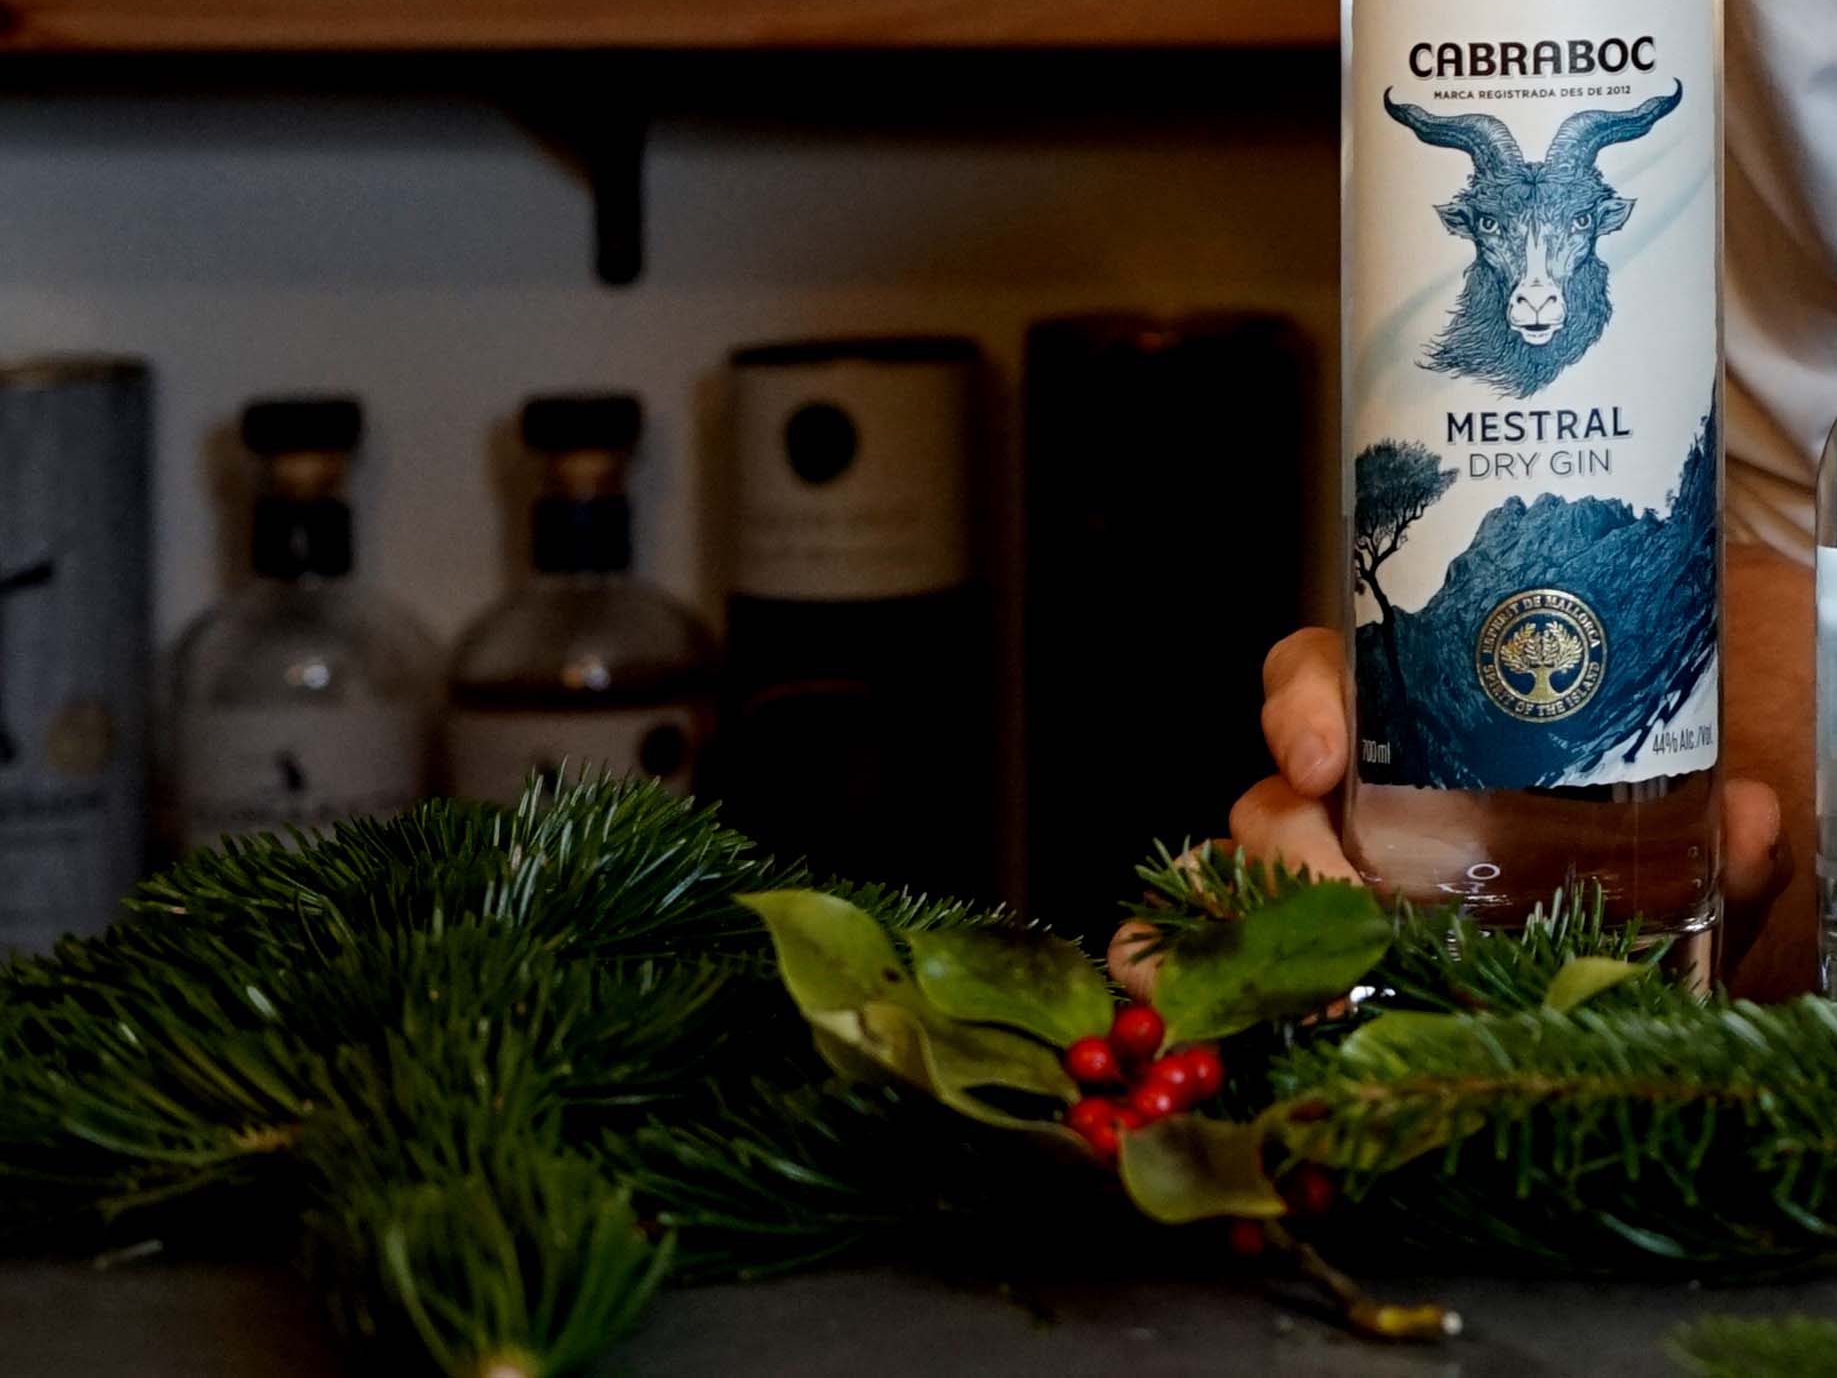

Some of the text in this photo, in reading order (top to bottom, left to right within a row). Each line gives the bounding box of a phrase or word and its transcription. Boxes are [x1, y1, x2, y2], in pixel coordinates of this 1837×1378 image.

[1409, 36, 1655, 78] CABRABOC
[1434, 85, 1631, 101] MARCA REGISTRADA DES DE 2012
[1447, 406, 1631, 443] MESTRAL
[1470, 448, 1611, 478] DRY GIN
[1522, 595, 1542, 610] DE
[1536, 701, 1566, 717] THE
